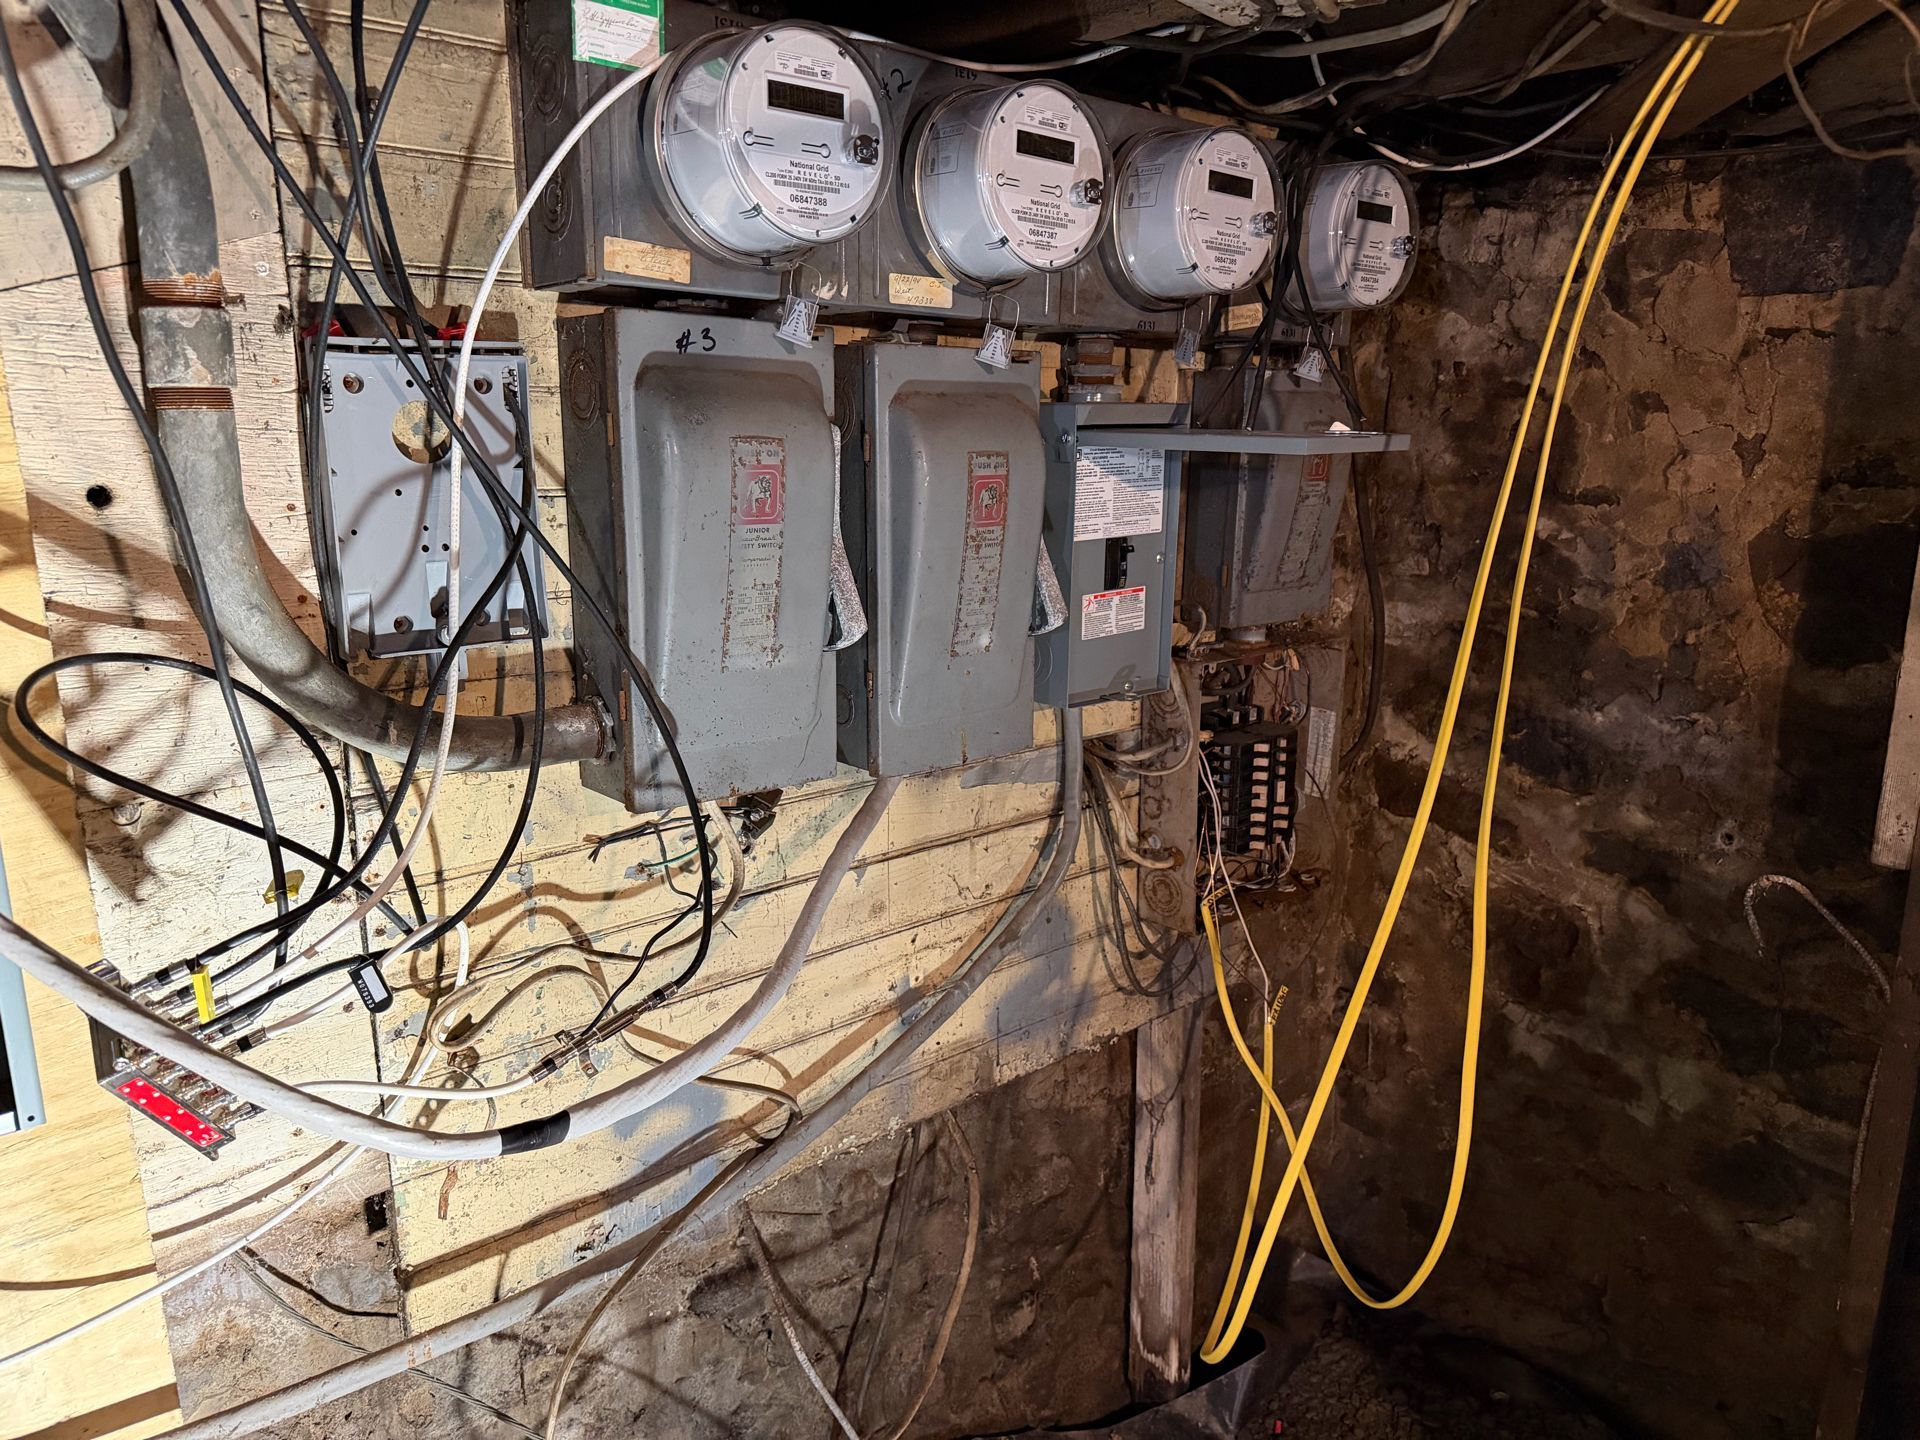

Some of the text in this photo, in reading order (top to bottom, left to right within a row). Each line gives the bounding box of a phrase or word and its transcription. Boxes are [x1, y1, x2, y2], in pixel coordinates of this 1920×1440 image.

[789, 160, 829, 172] National Grid
[789, 193, 828, 206] 06847388
[675, 327, 716, 354] #3
